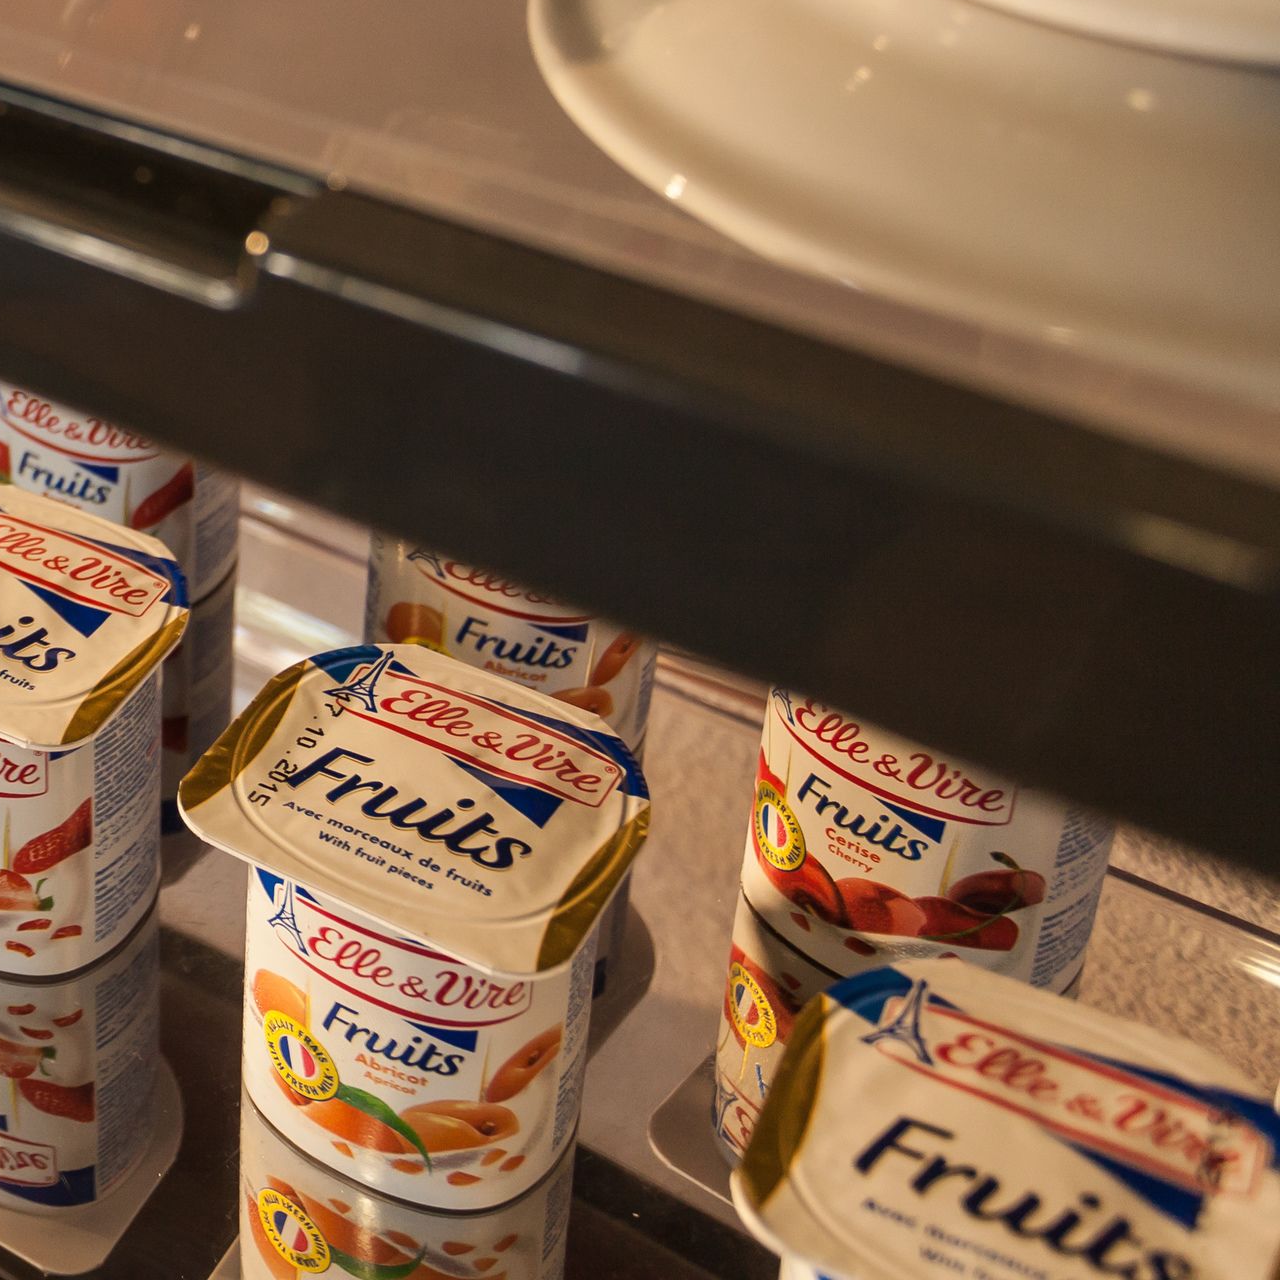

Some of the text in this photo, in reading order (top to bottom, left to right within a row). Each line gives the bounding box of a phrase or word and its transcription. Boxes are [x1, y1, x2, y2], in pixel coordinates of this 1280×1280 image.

[18, 451, 112, 505] Fruits
[43, 555, 69, 574] &
[70, 556, 150, 606] Vire
[455, 616, 577, 669] Fruits
[379, 689, 599, 794] Elle & Vire
[795, 699, 1005, 812] Elle & Vire
[287, 746, 532, 871] Fruits
[797, 772, 929, 862] Fruits
[283, 800, 494, 898] Avec morceaux de fruits
[317, 830, 435, 890] With fruit pieces
[825, 826, 881, 864] Cerise
[828, 843, 874, 874] Cherry
[307, 926, 526, 1010] Elle & Vire
[322, 1001, 466, 1077] Fruits
[354, 1051, 429, 1087] Abricot
[935, 1031, 1058, 1101] Elle
[363, 1070, 418, 1096] Apricot
